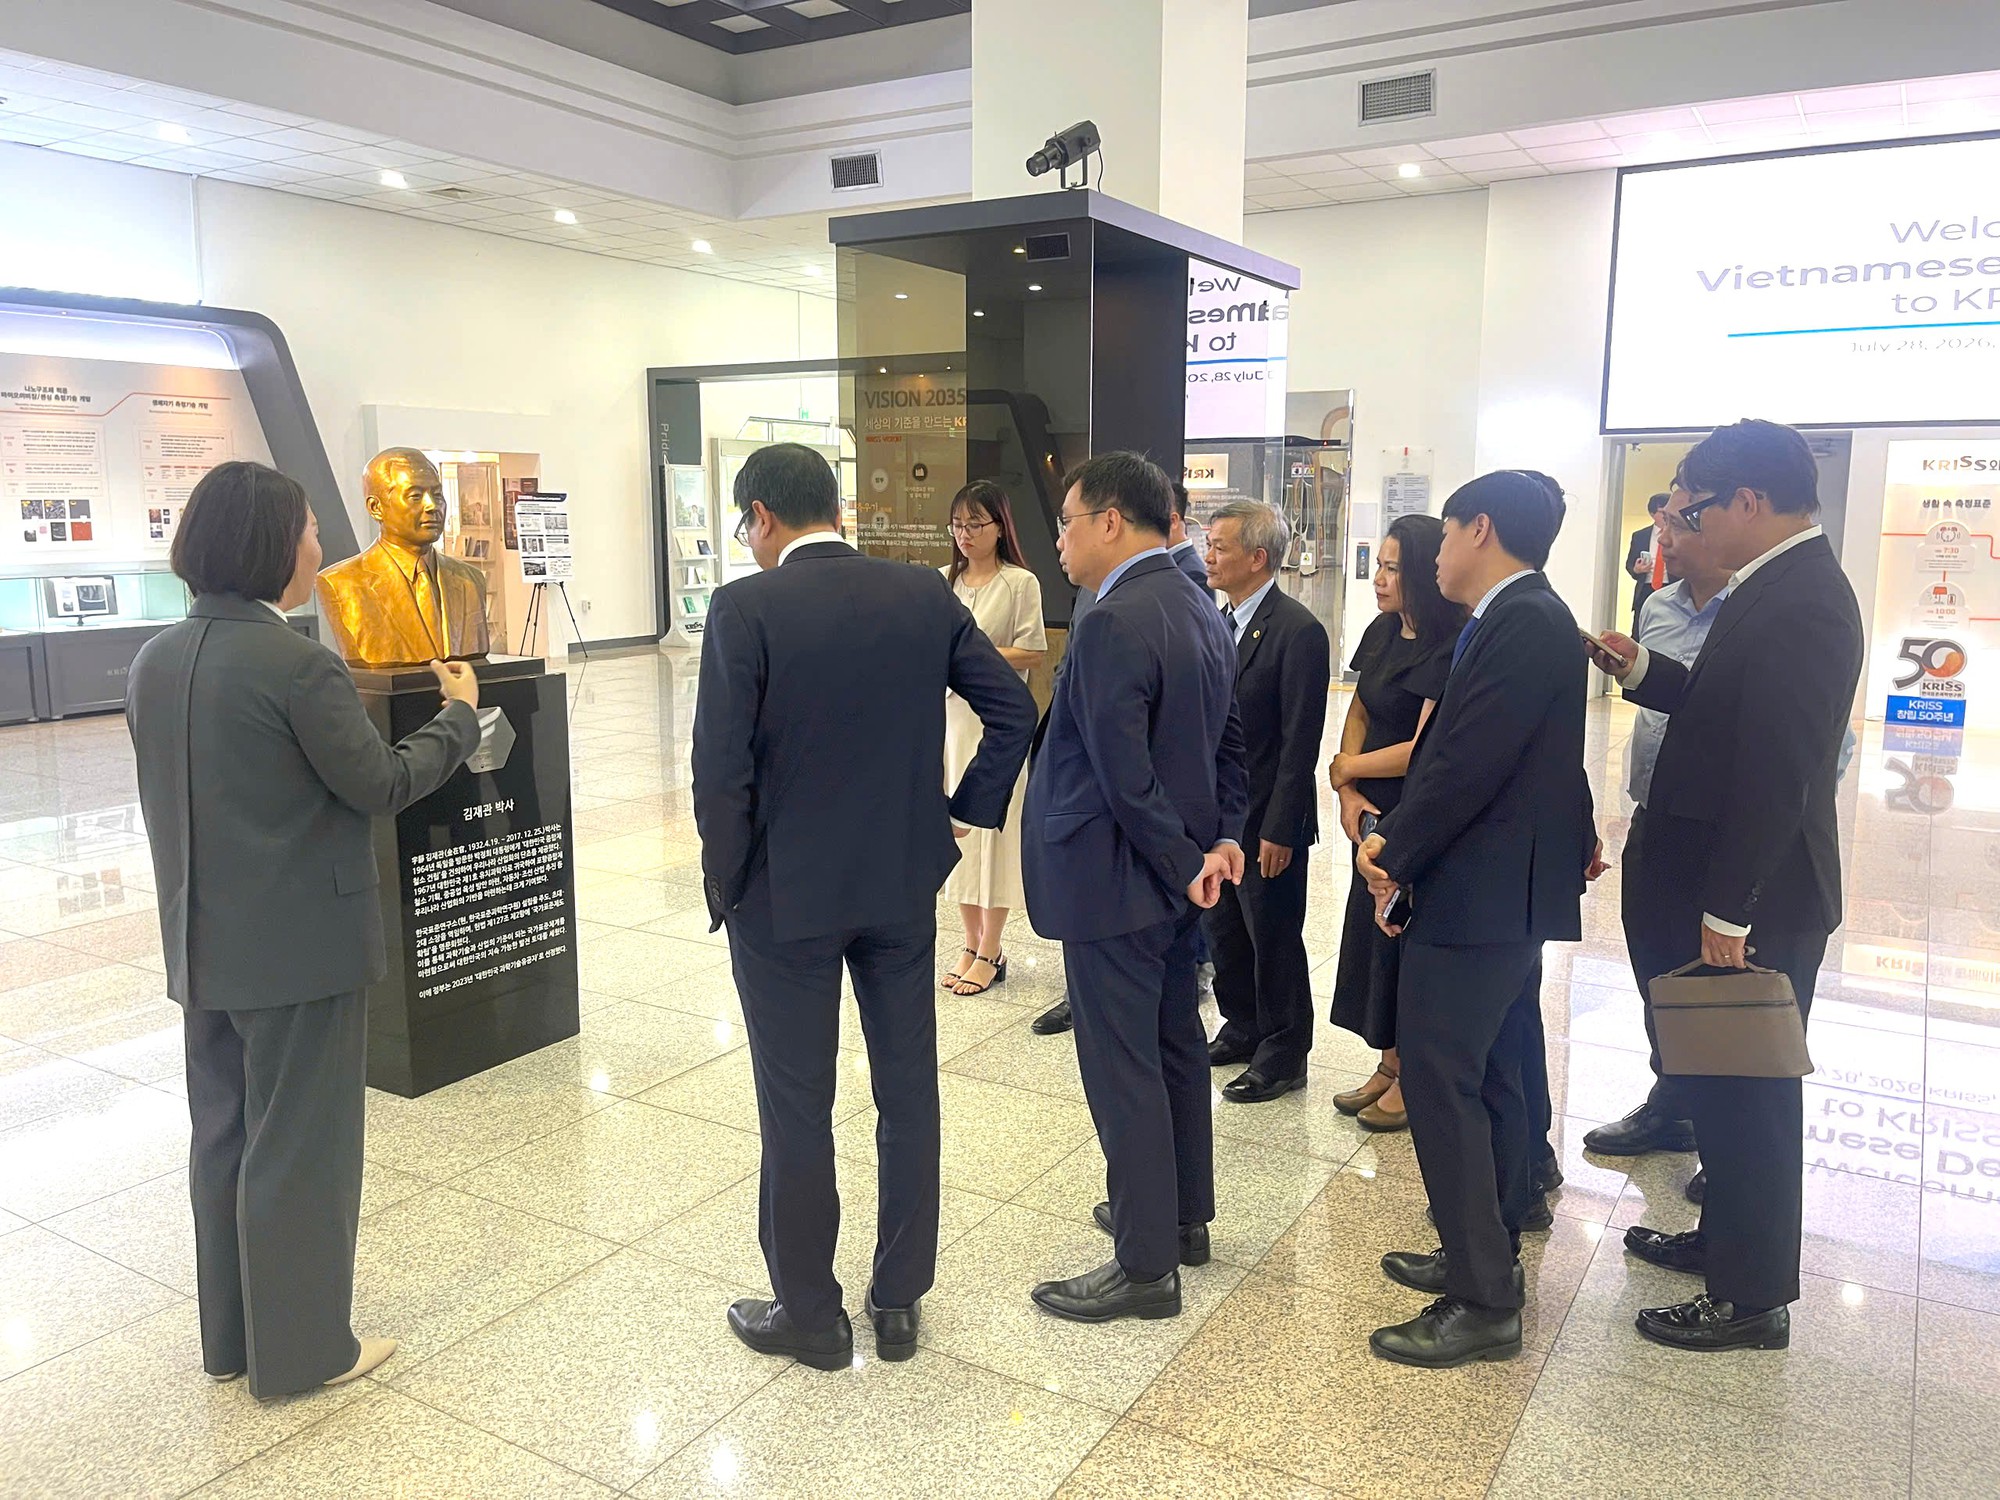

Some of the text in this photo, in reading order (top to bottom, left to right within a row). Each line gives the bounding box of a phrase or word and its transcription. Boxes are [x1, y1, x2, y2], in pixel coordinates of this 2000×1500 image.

[1697, 257, 2000, 291] Vietnamese
[1891, 294, 1937, 313] to
[1852, 341, 1890, 352] July
[864, 388, 966, 409] VISION 2035
[864, 417, 891, 430] 세상의
[894, 416, 921, 429] 기준을
[924, 416, 952, 428] 만드는
[1955, 499, 1991, 509] 측정표준
[1894, 639, 1965, 689] 50
[1922, 681, 1962, 692] KRISS
[1909, 700, 1943, 710] KRISS
[1897, 710, 1954, 723] 창립 50주년
[463, 798, 514, 820] 김재관 박사
